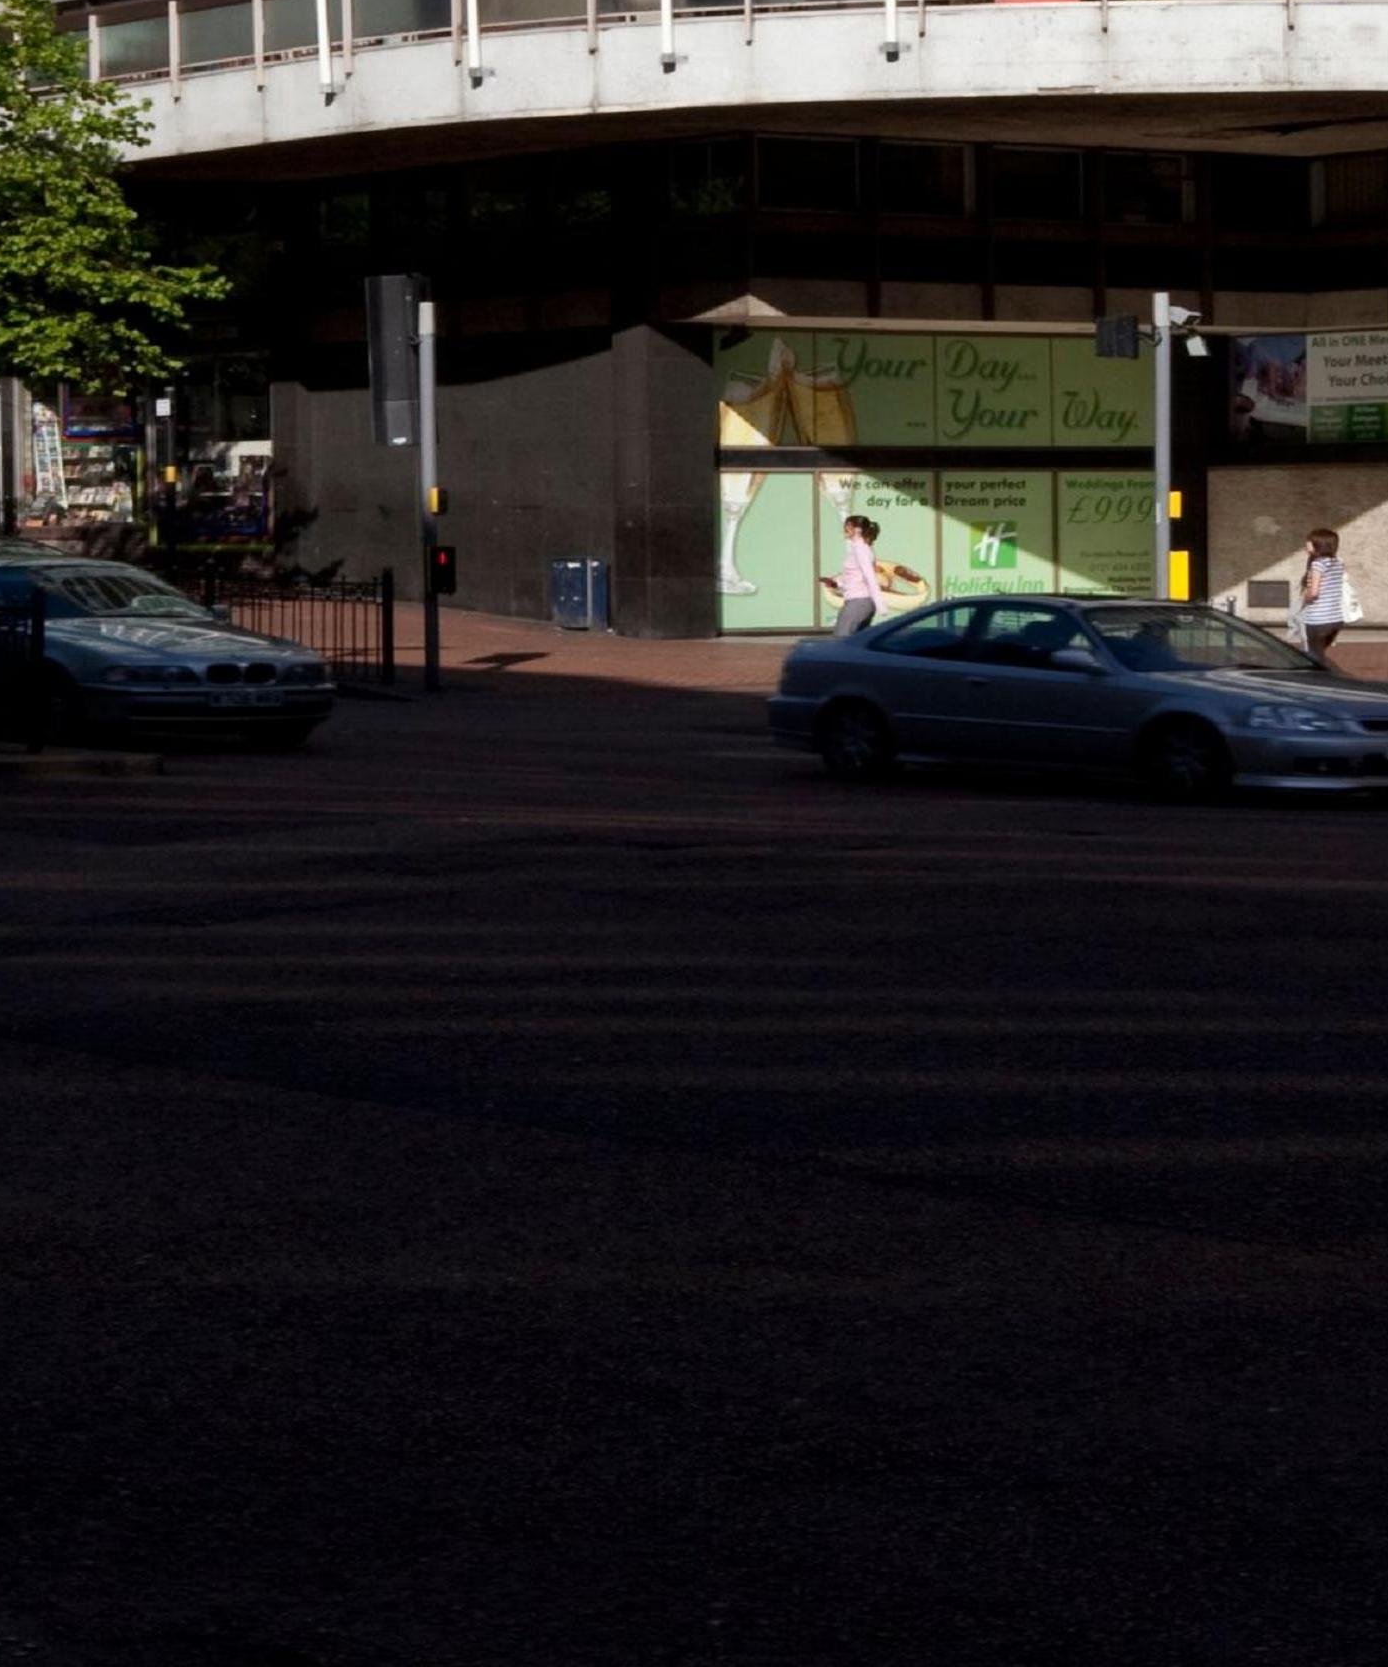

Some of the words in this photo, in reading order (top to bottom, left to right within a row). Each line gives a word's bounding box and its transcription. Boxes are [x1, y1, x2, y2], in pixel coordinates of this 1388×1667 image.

[1312, 337, 1326, 347] All
[1342, 336, 1366, 347] ONE
[833, 337, 926, 387] Your
[1323, 355, 1352, 367] Your
[1328, 375, 1357, 387] Your
[943, 388, 1038, 440] Your
[1062, 389, 1140, 442] Way.
[840, 478, 861, 489] We
[865, 479, 890, 489] can
[894, 477, 926, 489] offer
[945, 480, 975, 492] your
[980, 478, 1026, 492] perfect
[866, 495, 890, 508] day
[895, 495, 916, 506] for
[944, 496, 988, 507] Dream
[993, 495, 1026, 508] price
[1067, 495, 1153, 524] £999
